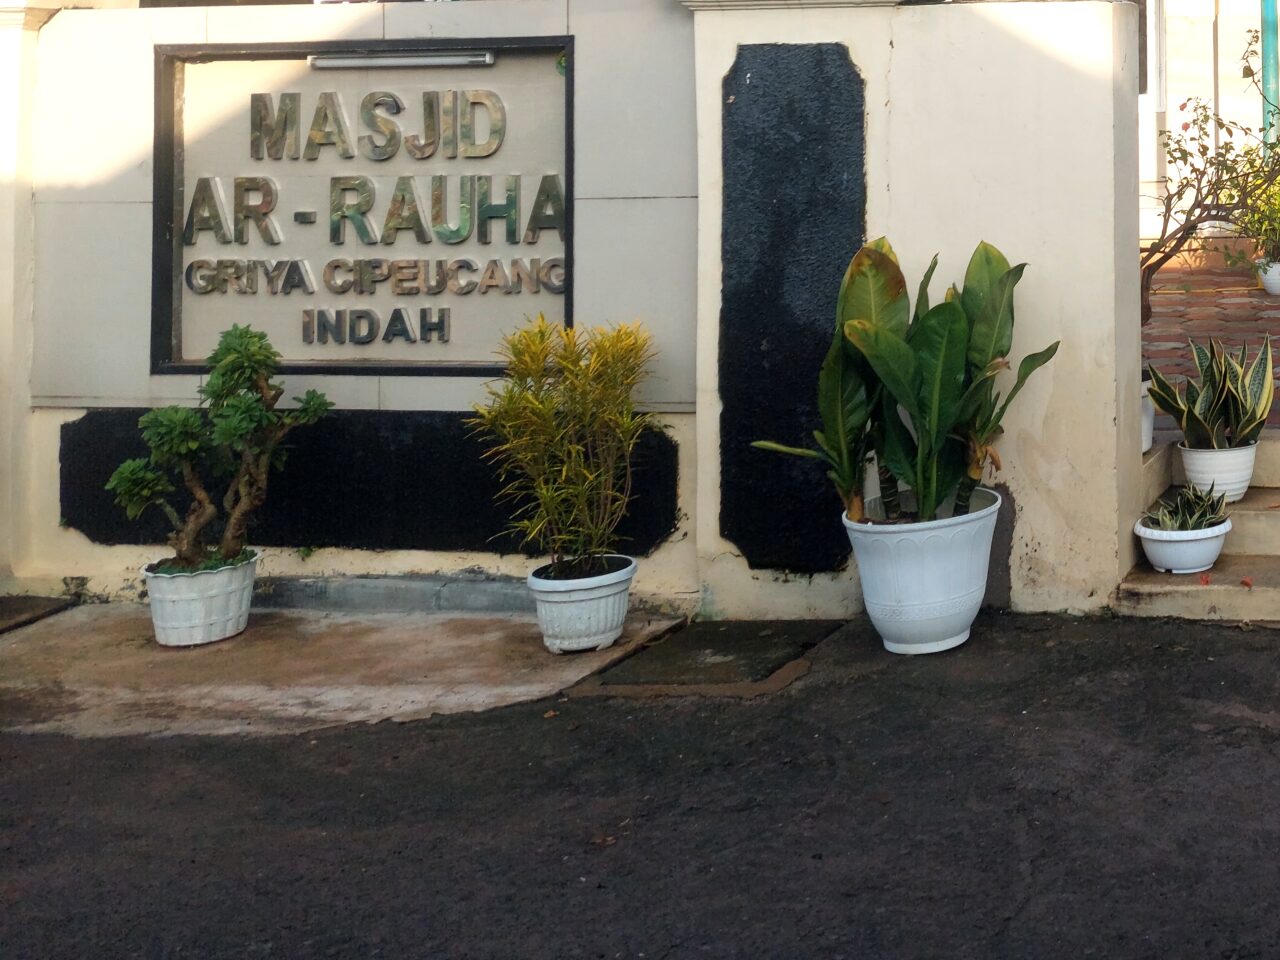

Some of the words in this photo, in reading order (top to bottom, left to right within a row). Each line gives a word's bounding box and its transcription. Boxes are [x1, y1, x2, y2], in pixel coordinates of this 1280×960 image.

[251, 90, 506, 160] MASJID
[185, 258, 316, 295] GRIYA
[322, 258, 566, 295] CIPEUCANG
[302, 307, 450, 344] INDAH
